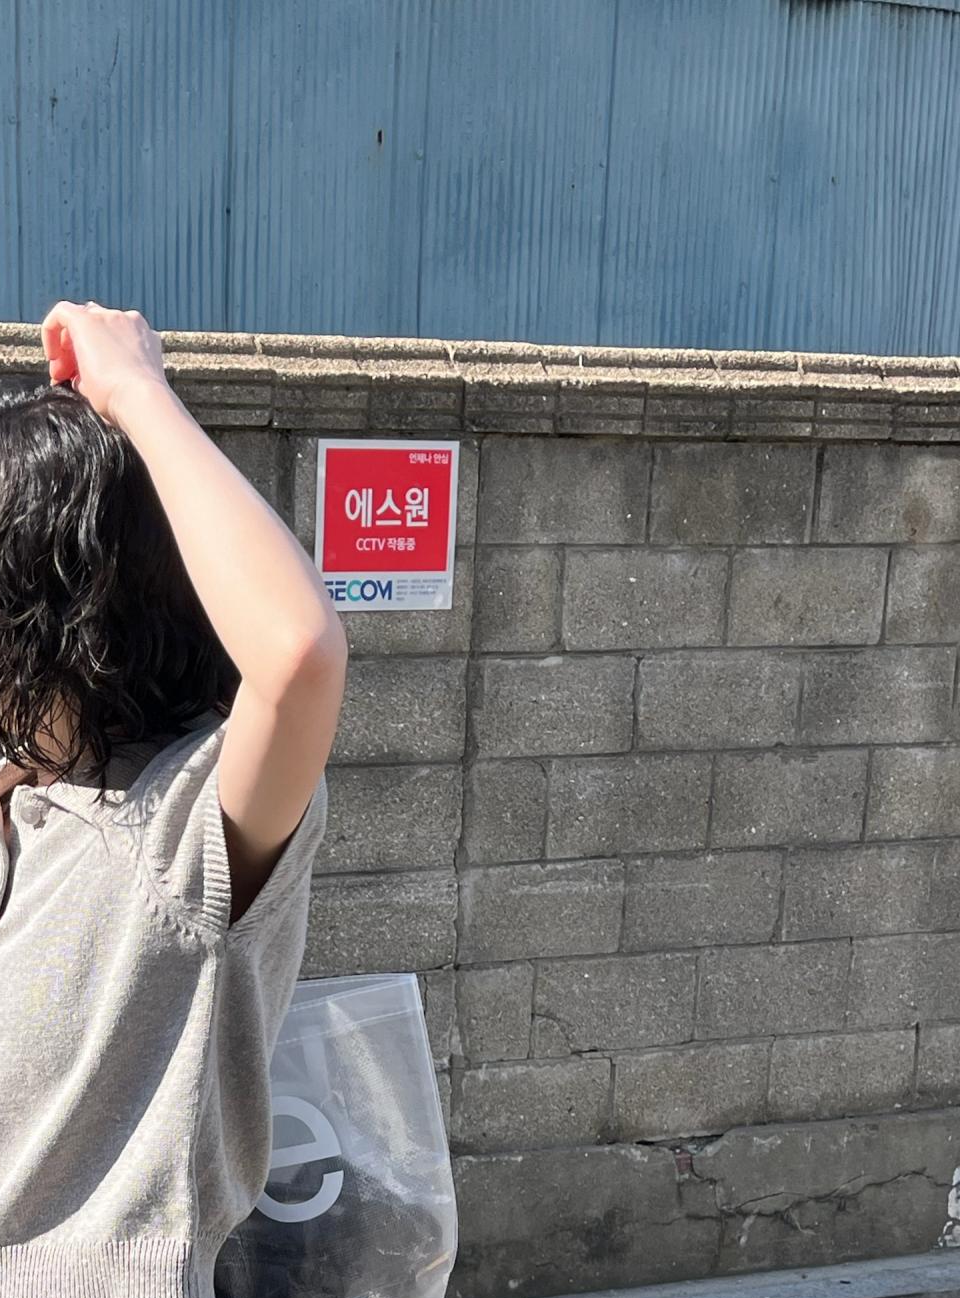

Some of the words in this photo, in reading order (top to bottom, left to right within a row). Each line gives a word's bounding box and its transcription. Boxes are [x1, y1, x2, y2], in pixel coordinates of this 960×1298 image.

[345, 487, 429, 528] 에스원
[355, 537, 385, 551] CCTV
[387, 537, 416, 551] 작동중
